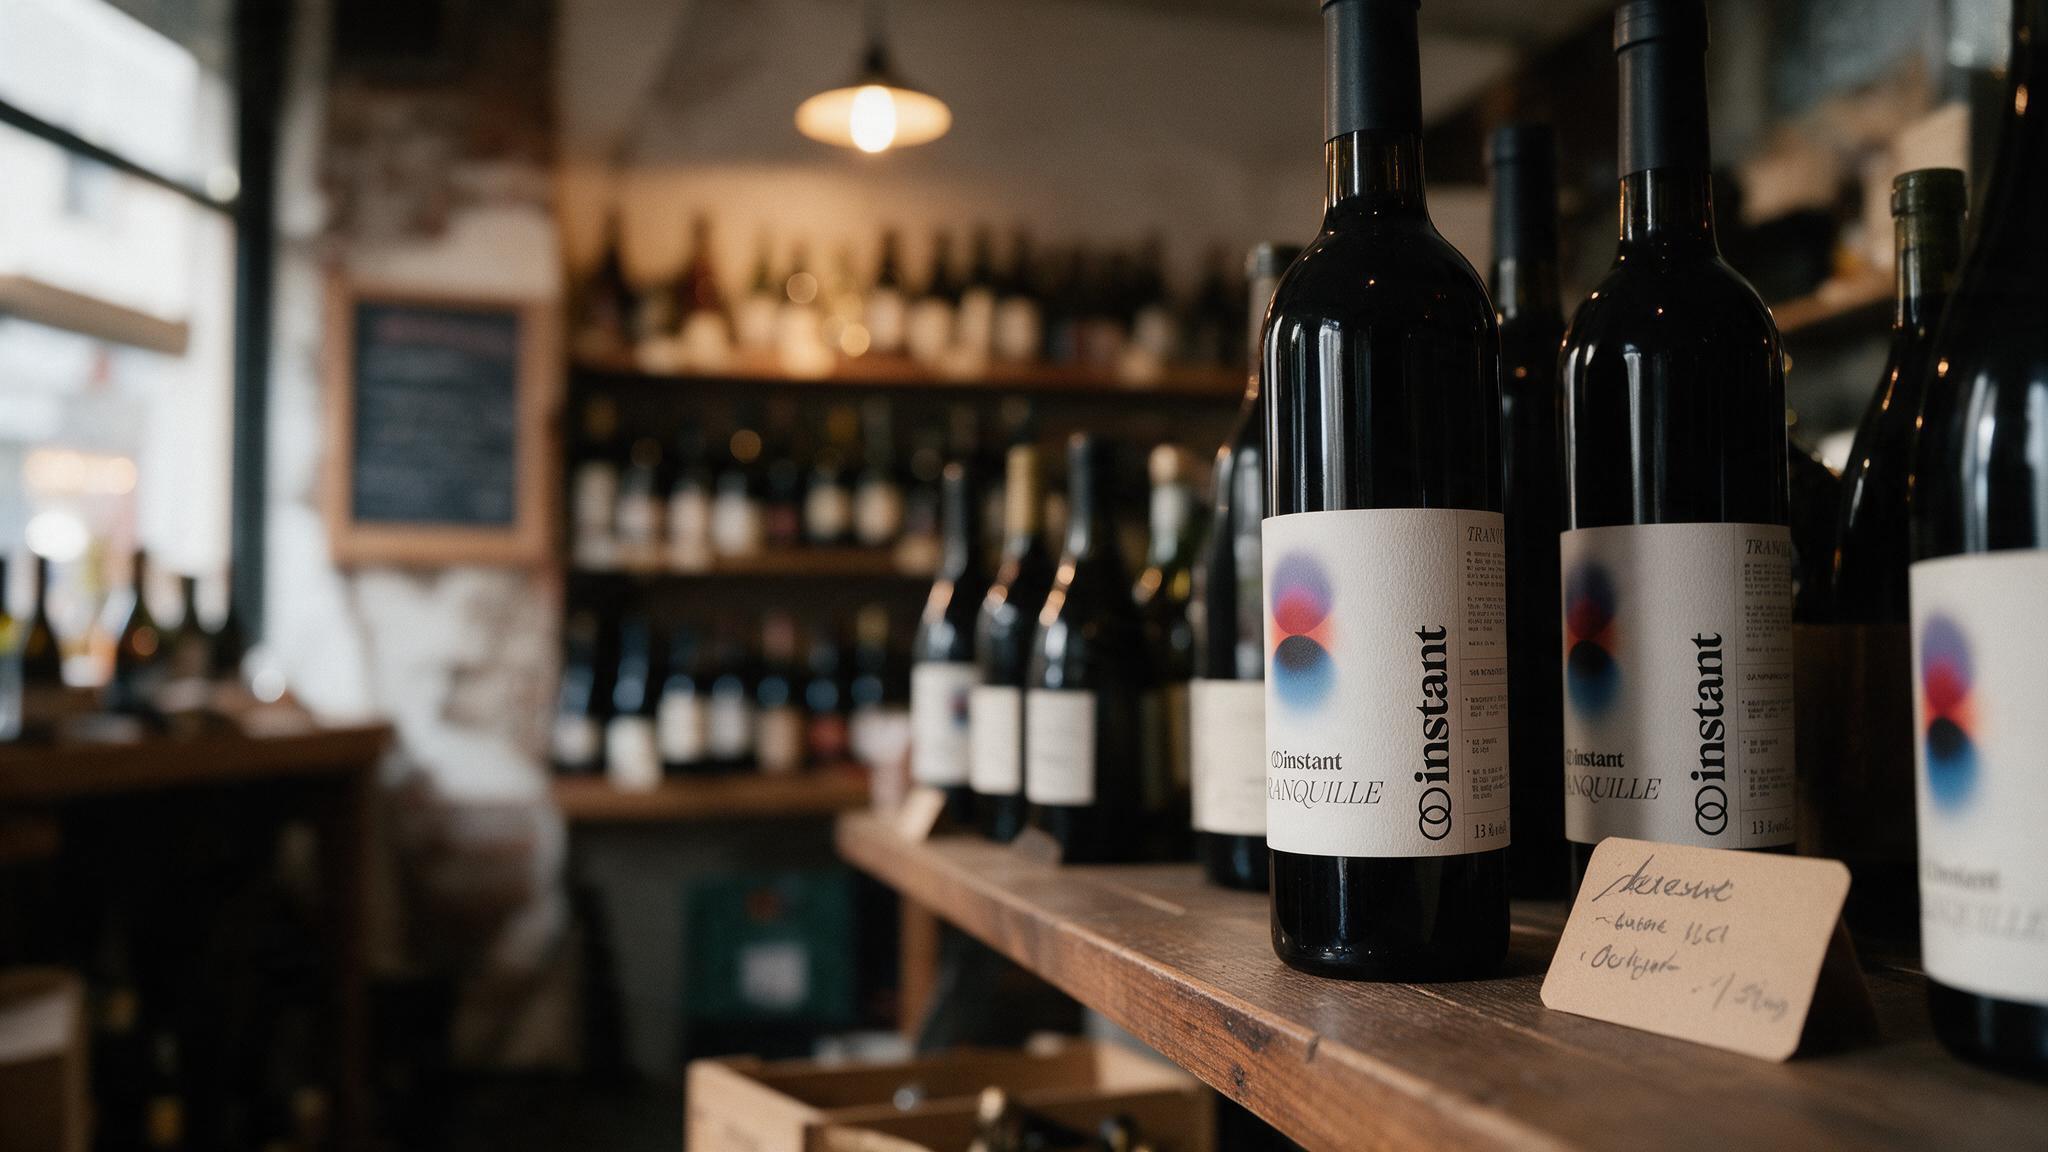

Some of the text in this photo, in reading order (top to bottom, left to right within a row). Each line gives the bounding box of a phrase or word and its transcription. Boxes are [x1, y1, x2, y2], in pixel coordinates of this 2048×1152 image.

[1414, 625, 1450, 785] instant
[1690, 632, 1726, 782] instant
[1268, 777, 1384, 809] RANQUILLE
[1284, 750, 1343, 770] instant
